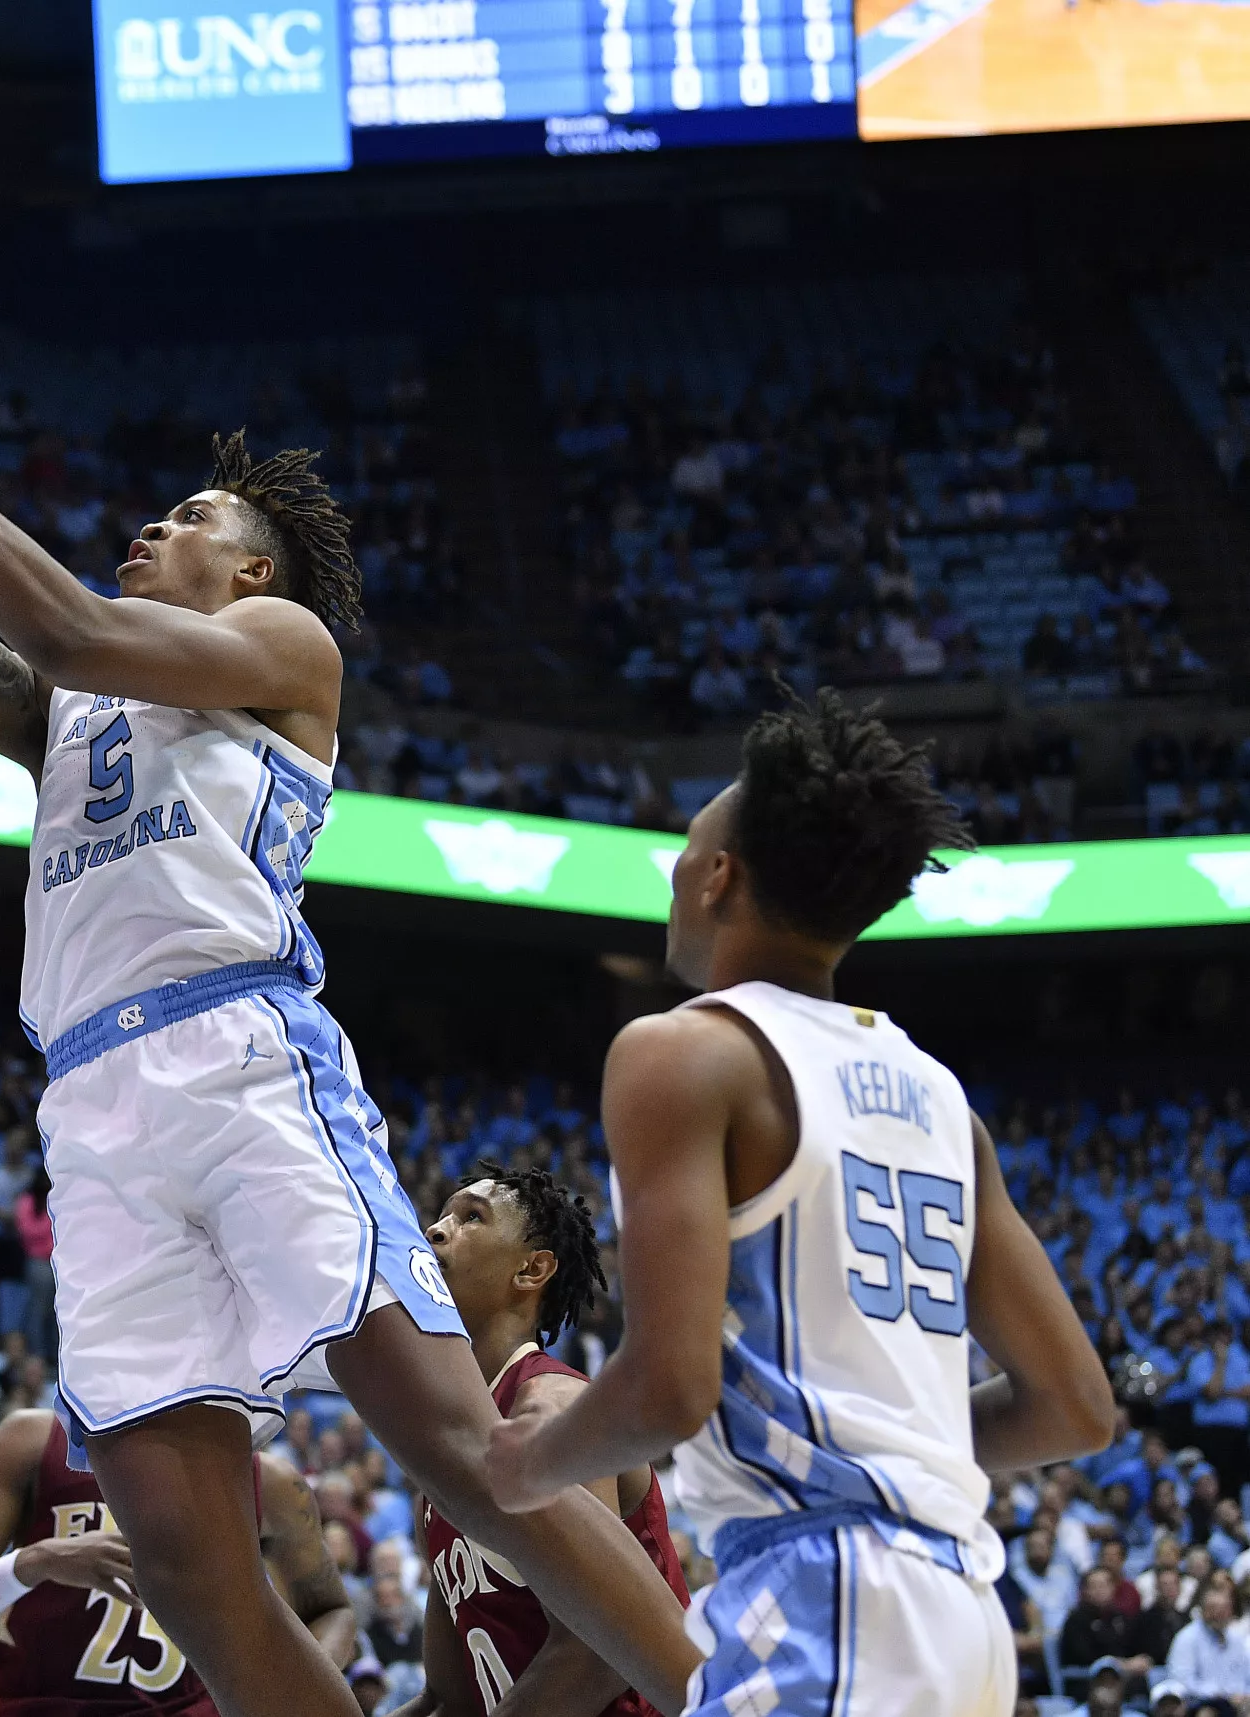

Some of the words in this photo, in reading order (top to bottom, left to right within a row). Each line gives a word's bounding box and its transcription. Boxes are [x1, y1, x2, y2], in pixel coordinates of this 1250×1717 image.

[157, 8, 324, 77] UNC
[84, 711, 134, 824] 5
[42, 800, 196, 893] CAROLINA
[836, 1060, 933, 1136] KEELING
[840, 1150, 968, 1337] 55
[75, 1577, 186, 1693] 25
